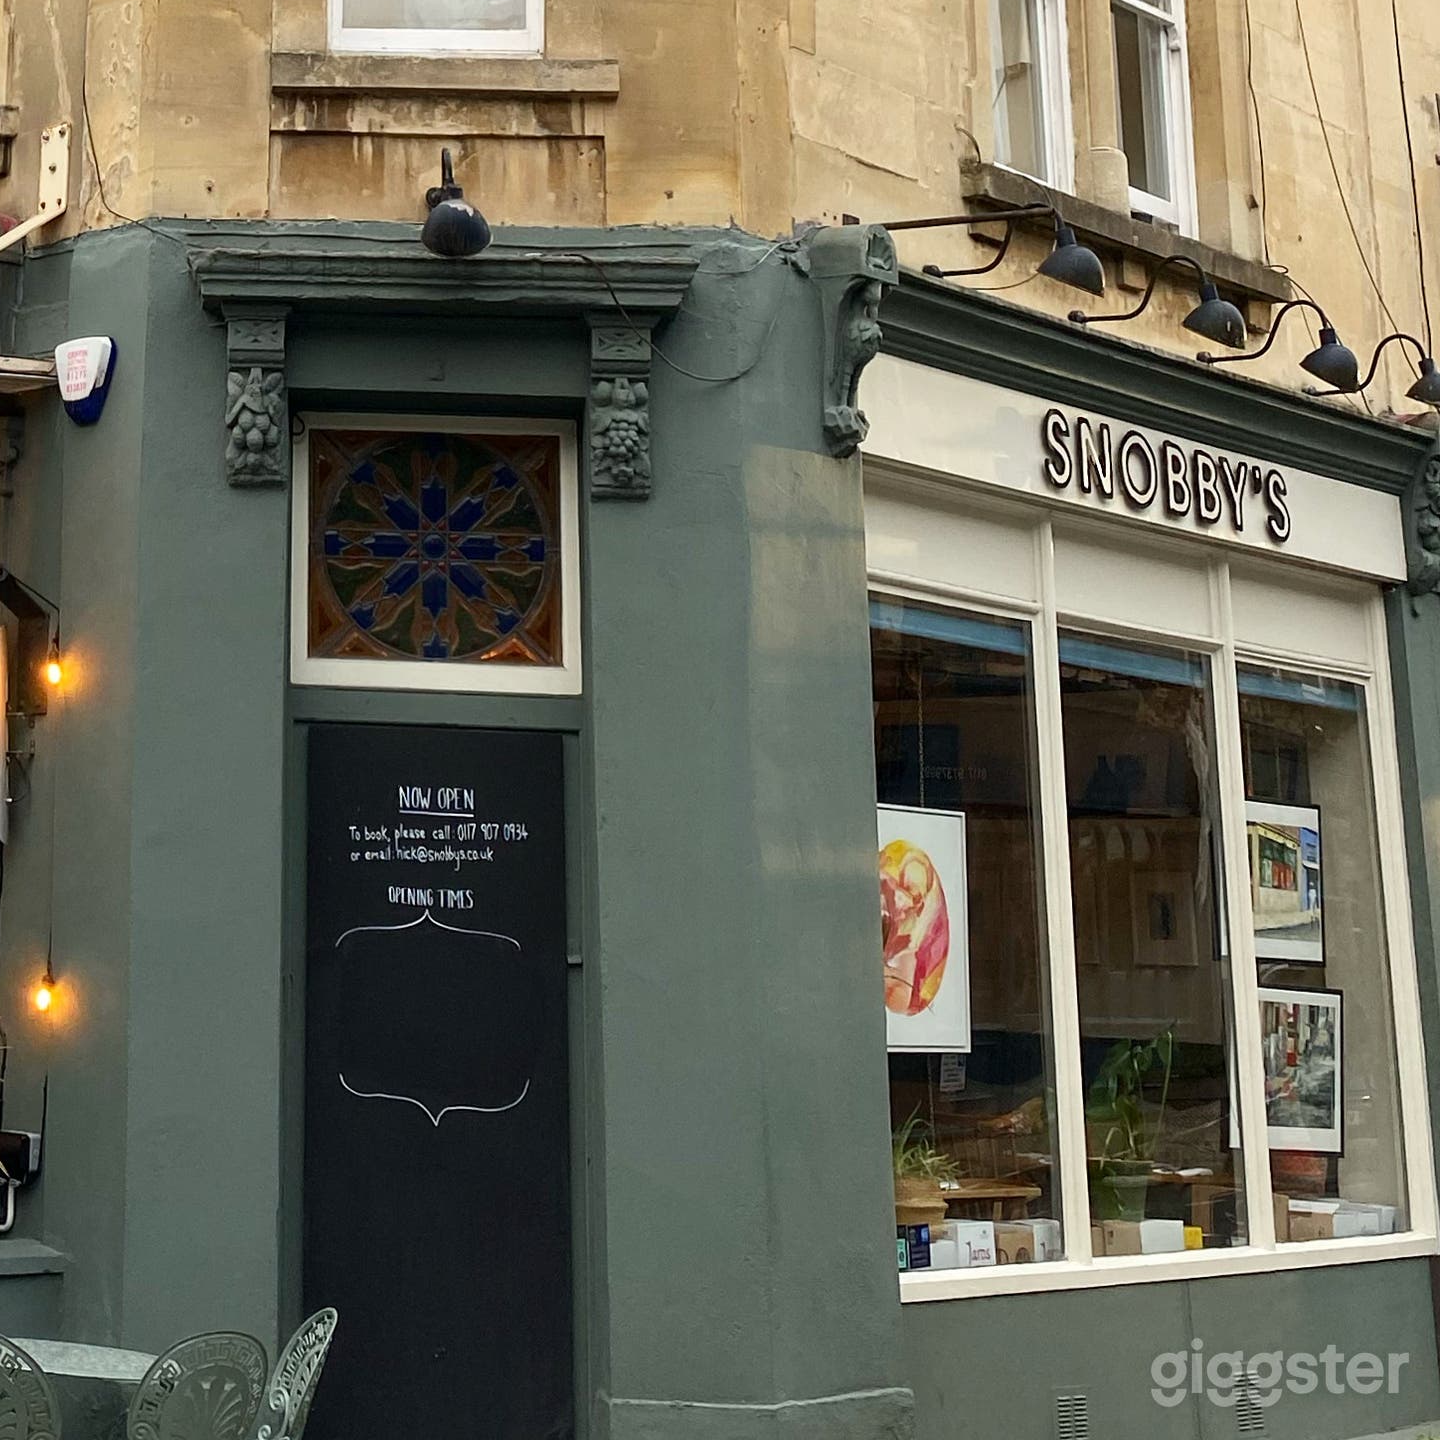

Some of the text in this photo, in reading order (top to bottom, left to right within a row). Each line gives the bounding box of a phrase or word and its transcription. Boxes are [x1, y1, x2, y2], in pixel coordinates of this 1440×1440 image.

[1042, 408, 1291, 543] SNOBBY'S
[399, 786, 474, 810] NOW OPEN
[349, 825, 361, 841] To
[394, 823, 426, 850] please
[457, 822, 477, 841] 0117
[480, 822, 500, 841] 907
[503, 822, 529, 841] 0934
[350, 851, 361, 861] or
[388, 886, 474, 909] OPENING TIMES
